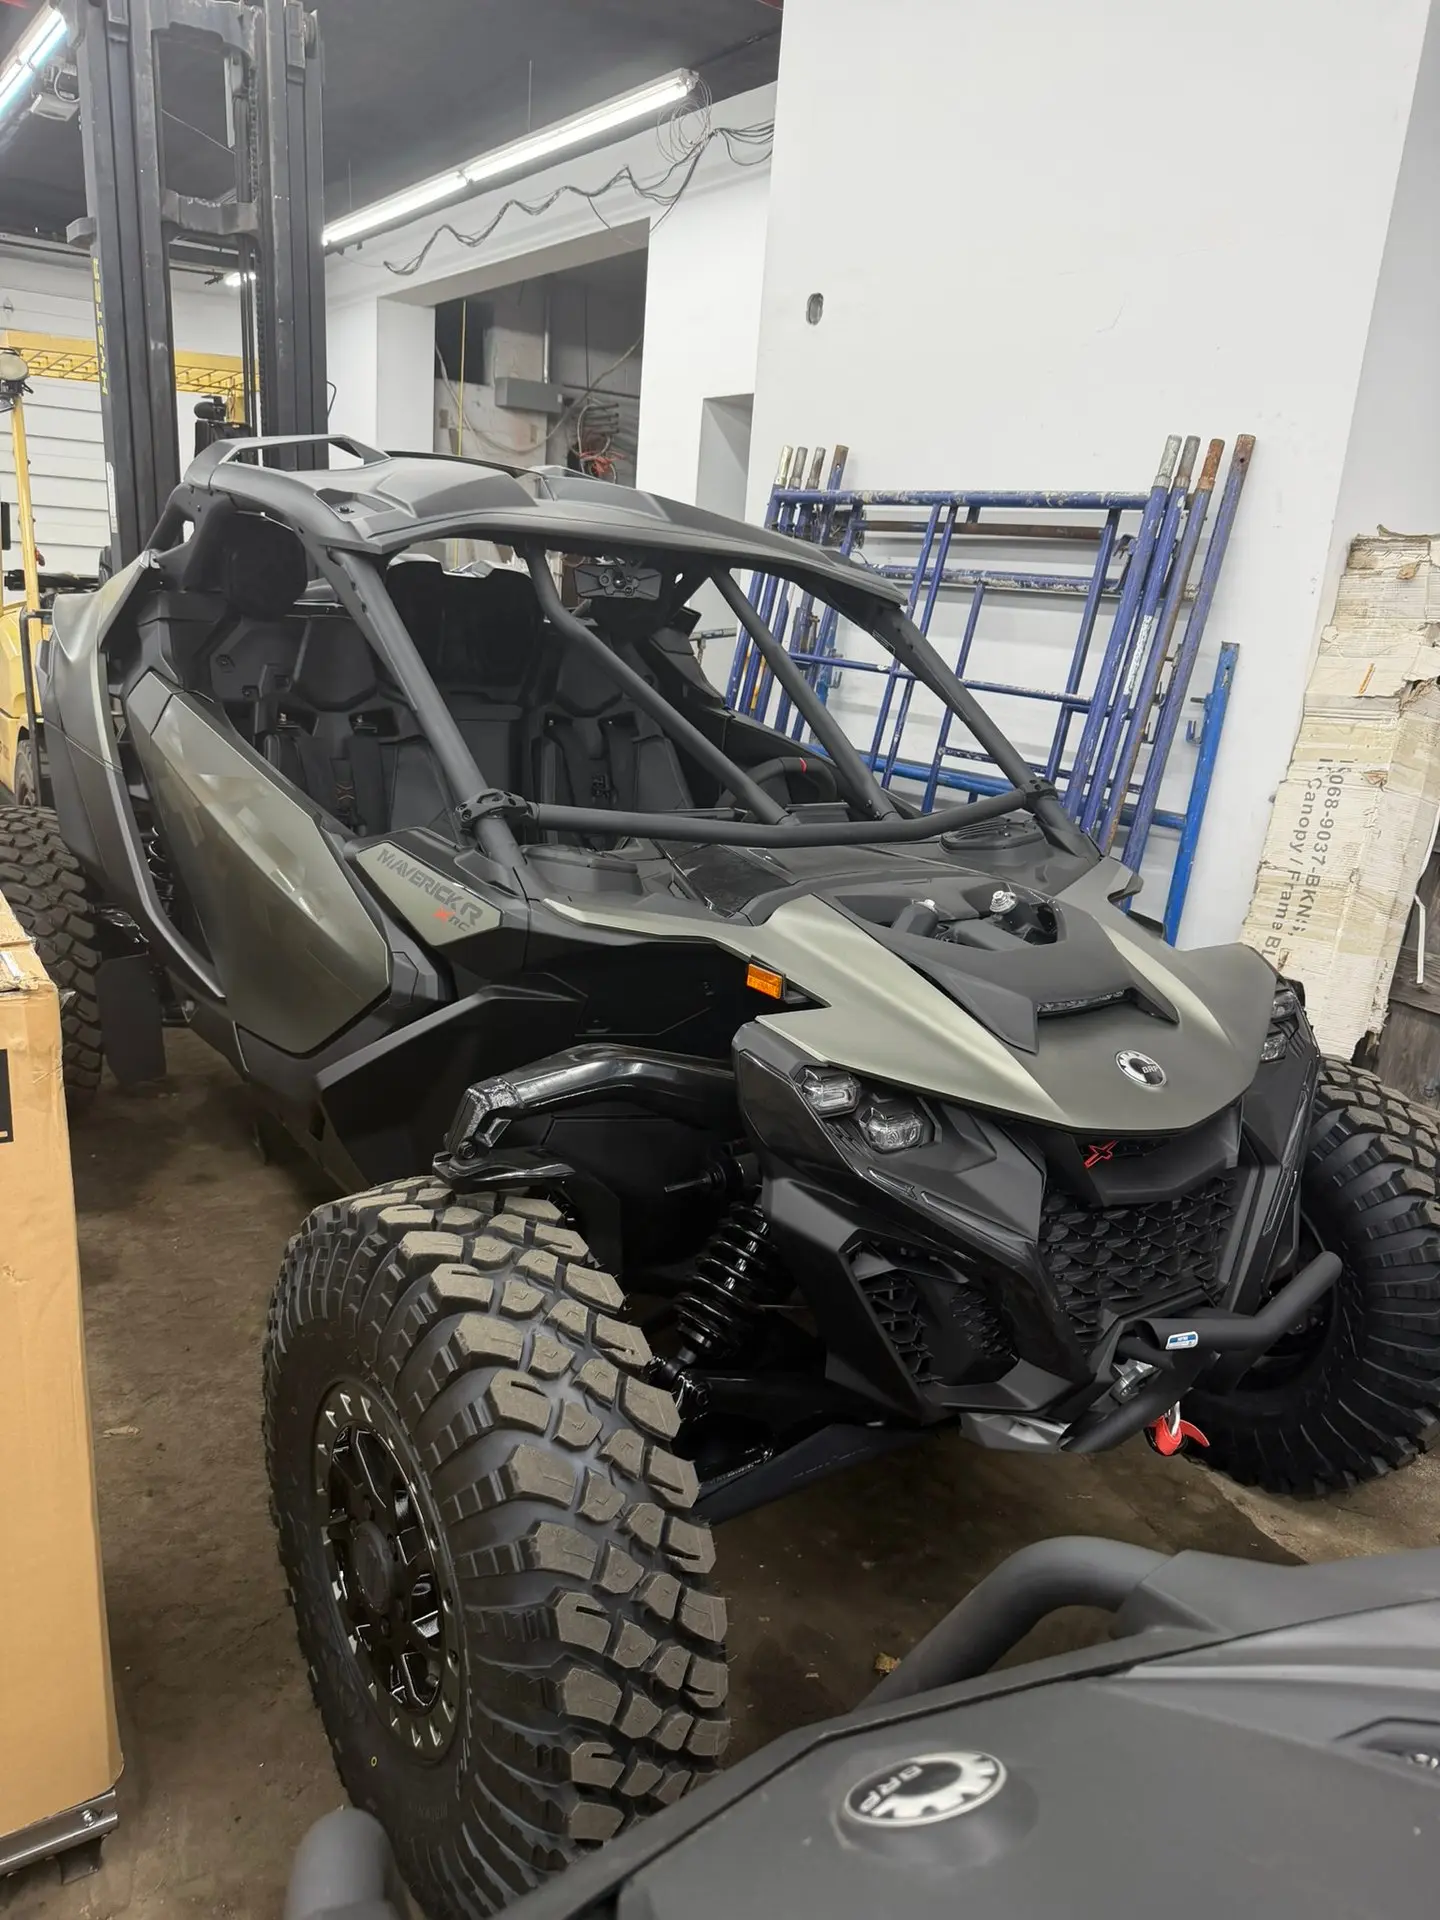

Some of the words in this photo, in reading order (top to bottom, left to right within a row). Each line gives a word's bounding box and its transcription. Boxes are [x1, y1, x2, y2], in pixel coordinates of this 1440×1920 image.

[1289, 777, 1323, 854] Canopy
[377, 848, 464, 912] MAVERICK
[460, 902, 483, 926] R
[1290, 857, 1304, 866] /
[1271, 869, 1301, 932] Frame
[859, 1764, 923, 1812] BRP
